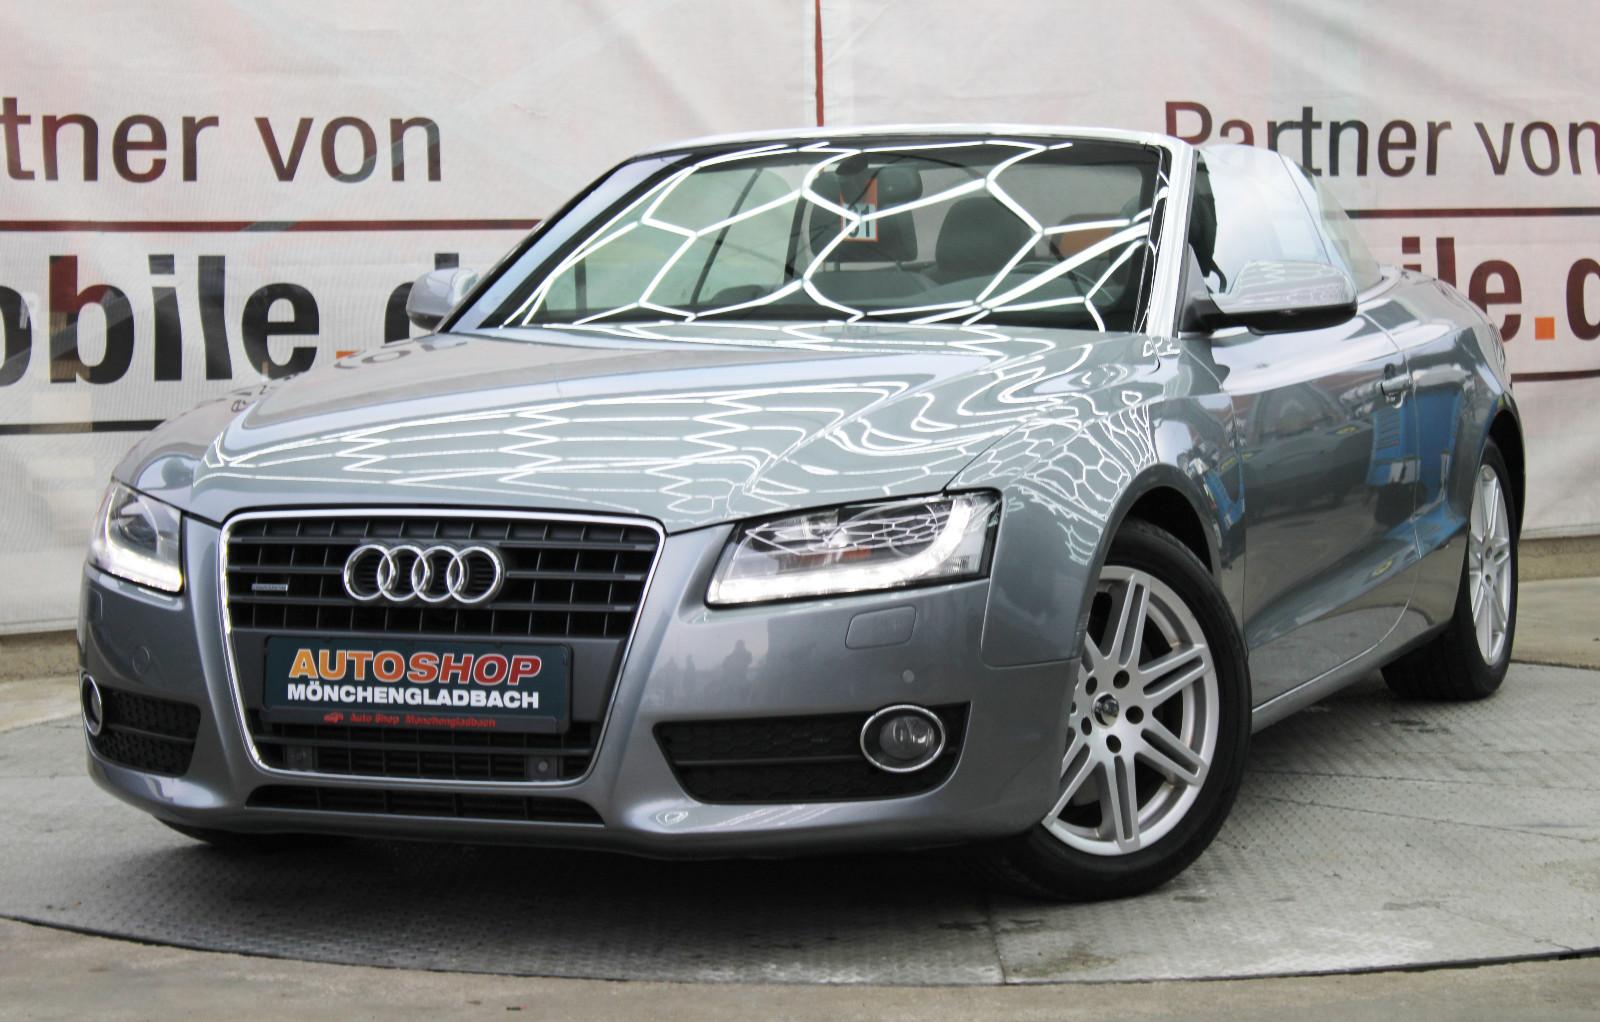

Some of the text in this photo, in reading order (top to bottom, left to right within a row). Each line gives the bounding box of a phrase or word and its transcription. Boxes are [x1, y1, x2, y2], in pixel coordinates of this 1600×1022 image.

[255, 116, 442, 182] von
[288, 648, 542, 686] AUTOSHOP
[287, 683, 539, 710] MÖNCHENGLADBACH
